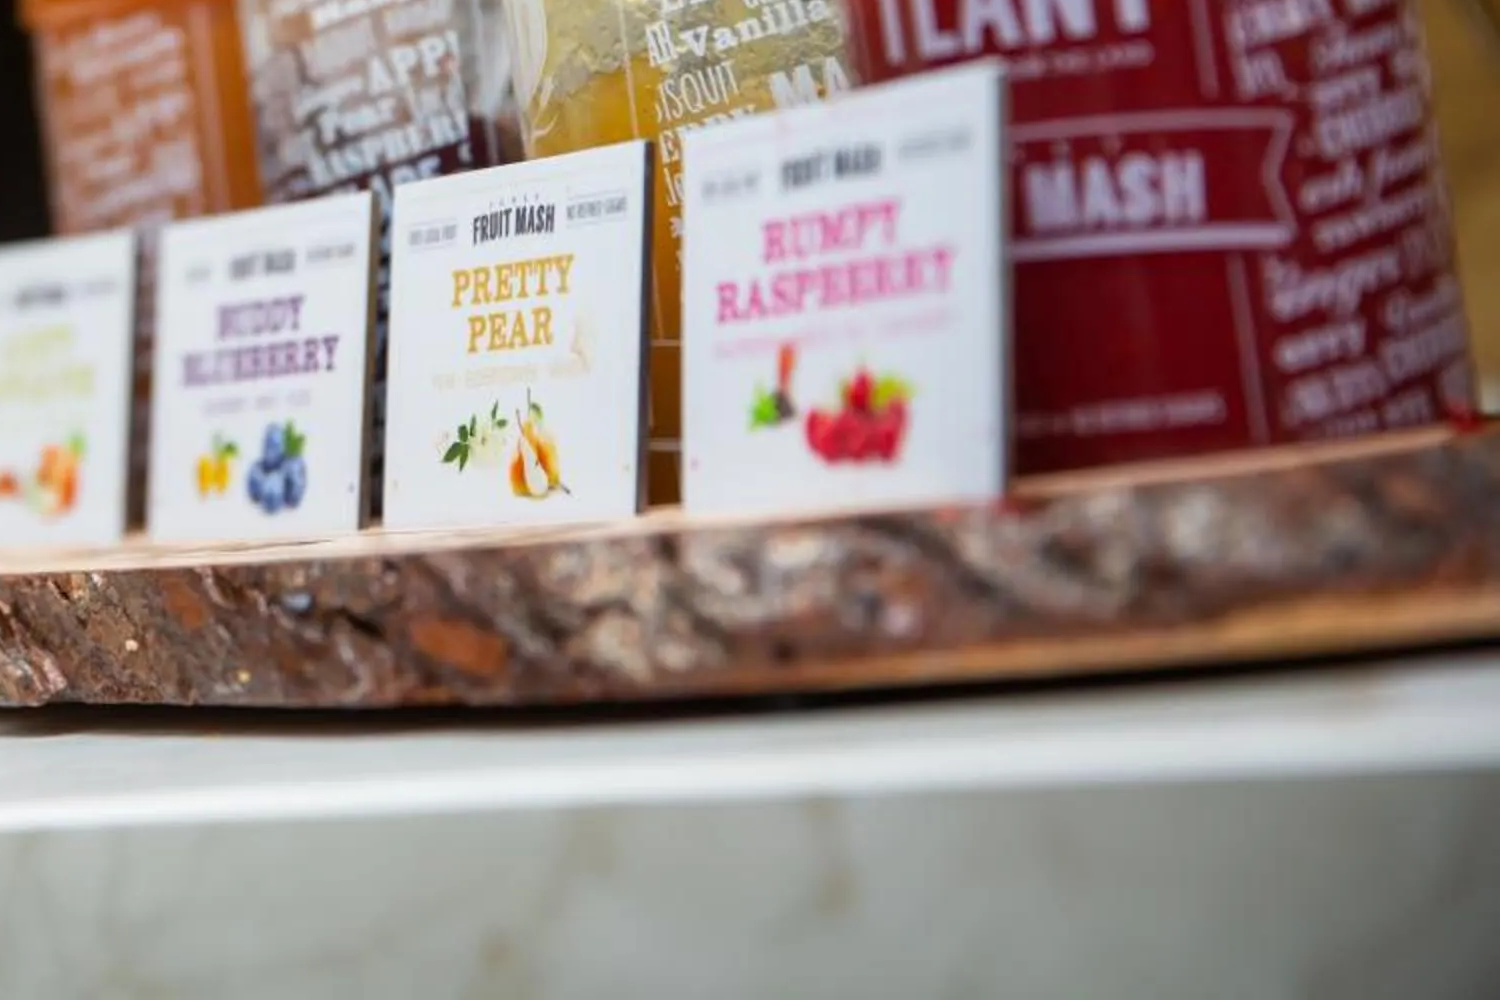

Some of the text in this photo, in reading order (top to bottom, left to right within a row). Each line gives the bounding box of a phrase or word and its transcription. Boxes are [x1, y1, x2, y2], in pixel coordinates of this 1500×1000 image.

[1024, 150, 1205, 231] MASH
[472, 207, 512, 247] FRUIT
[514, 203, 555, 236] MASH
[451, 253, 575, 309] PRETTY
[715, 246, 956, 324] RASPBERRY
[466, 305, 554, 354] PEAR
